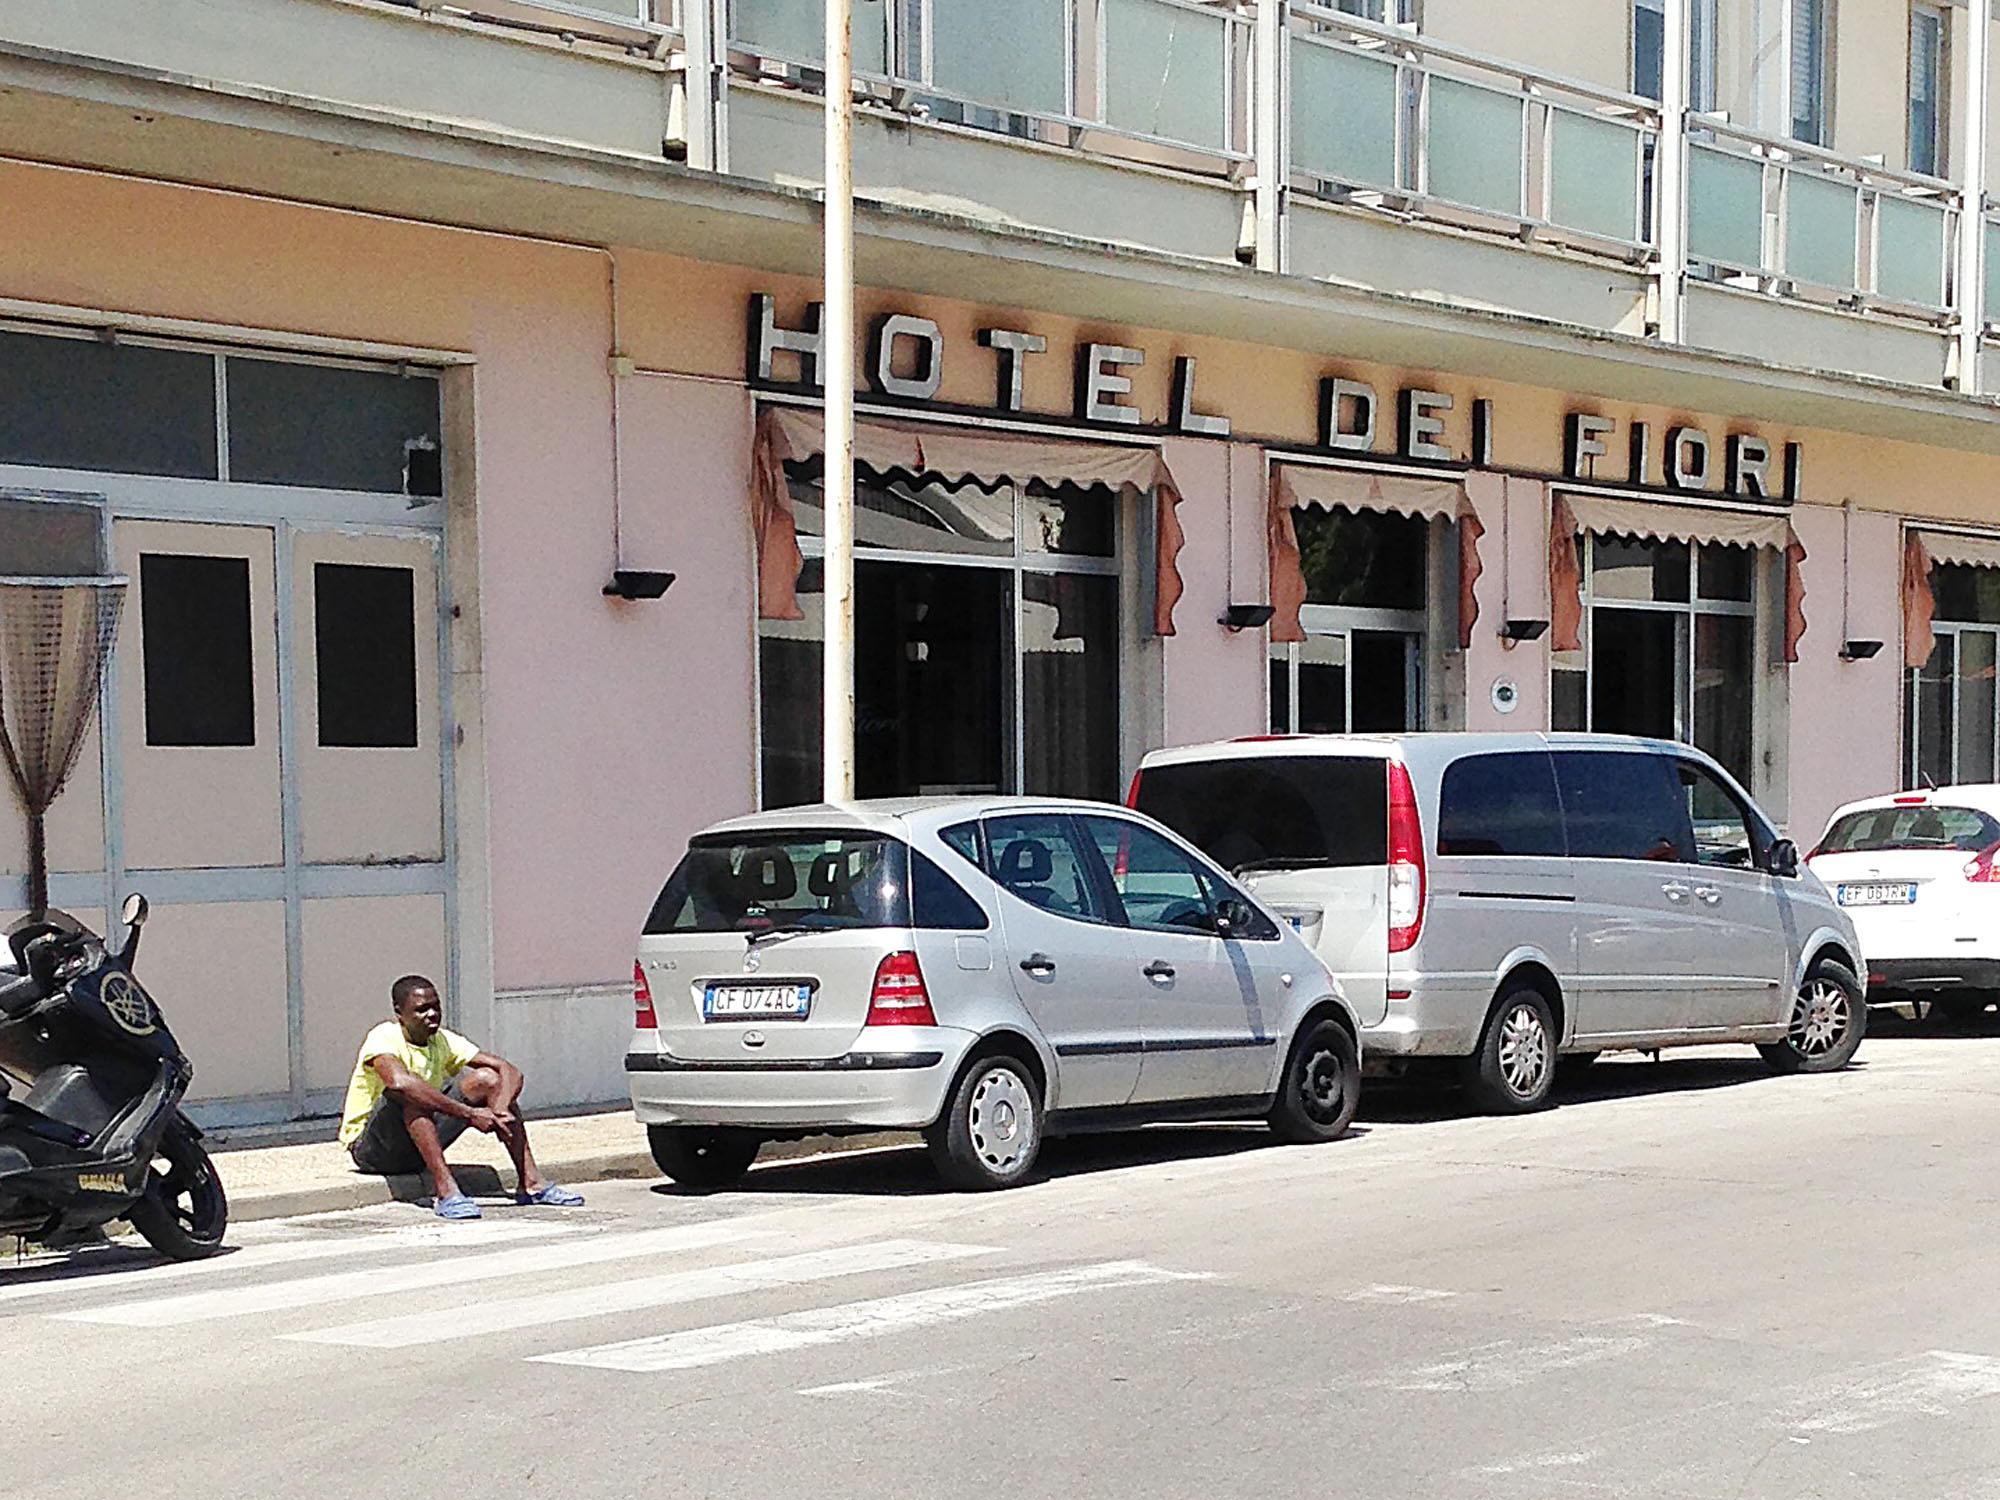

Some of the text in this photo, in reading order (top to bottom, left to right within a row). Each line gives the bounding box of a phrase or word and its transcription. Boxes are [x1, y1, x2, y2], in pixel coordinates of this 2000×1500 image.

[746, 292, 1802, 500] HOTEL DEI FIORI
[716, 987, 796, 1010] CF 074AC
